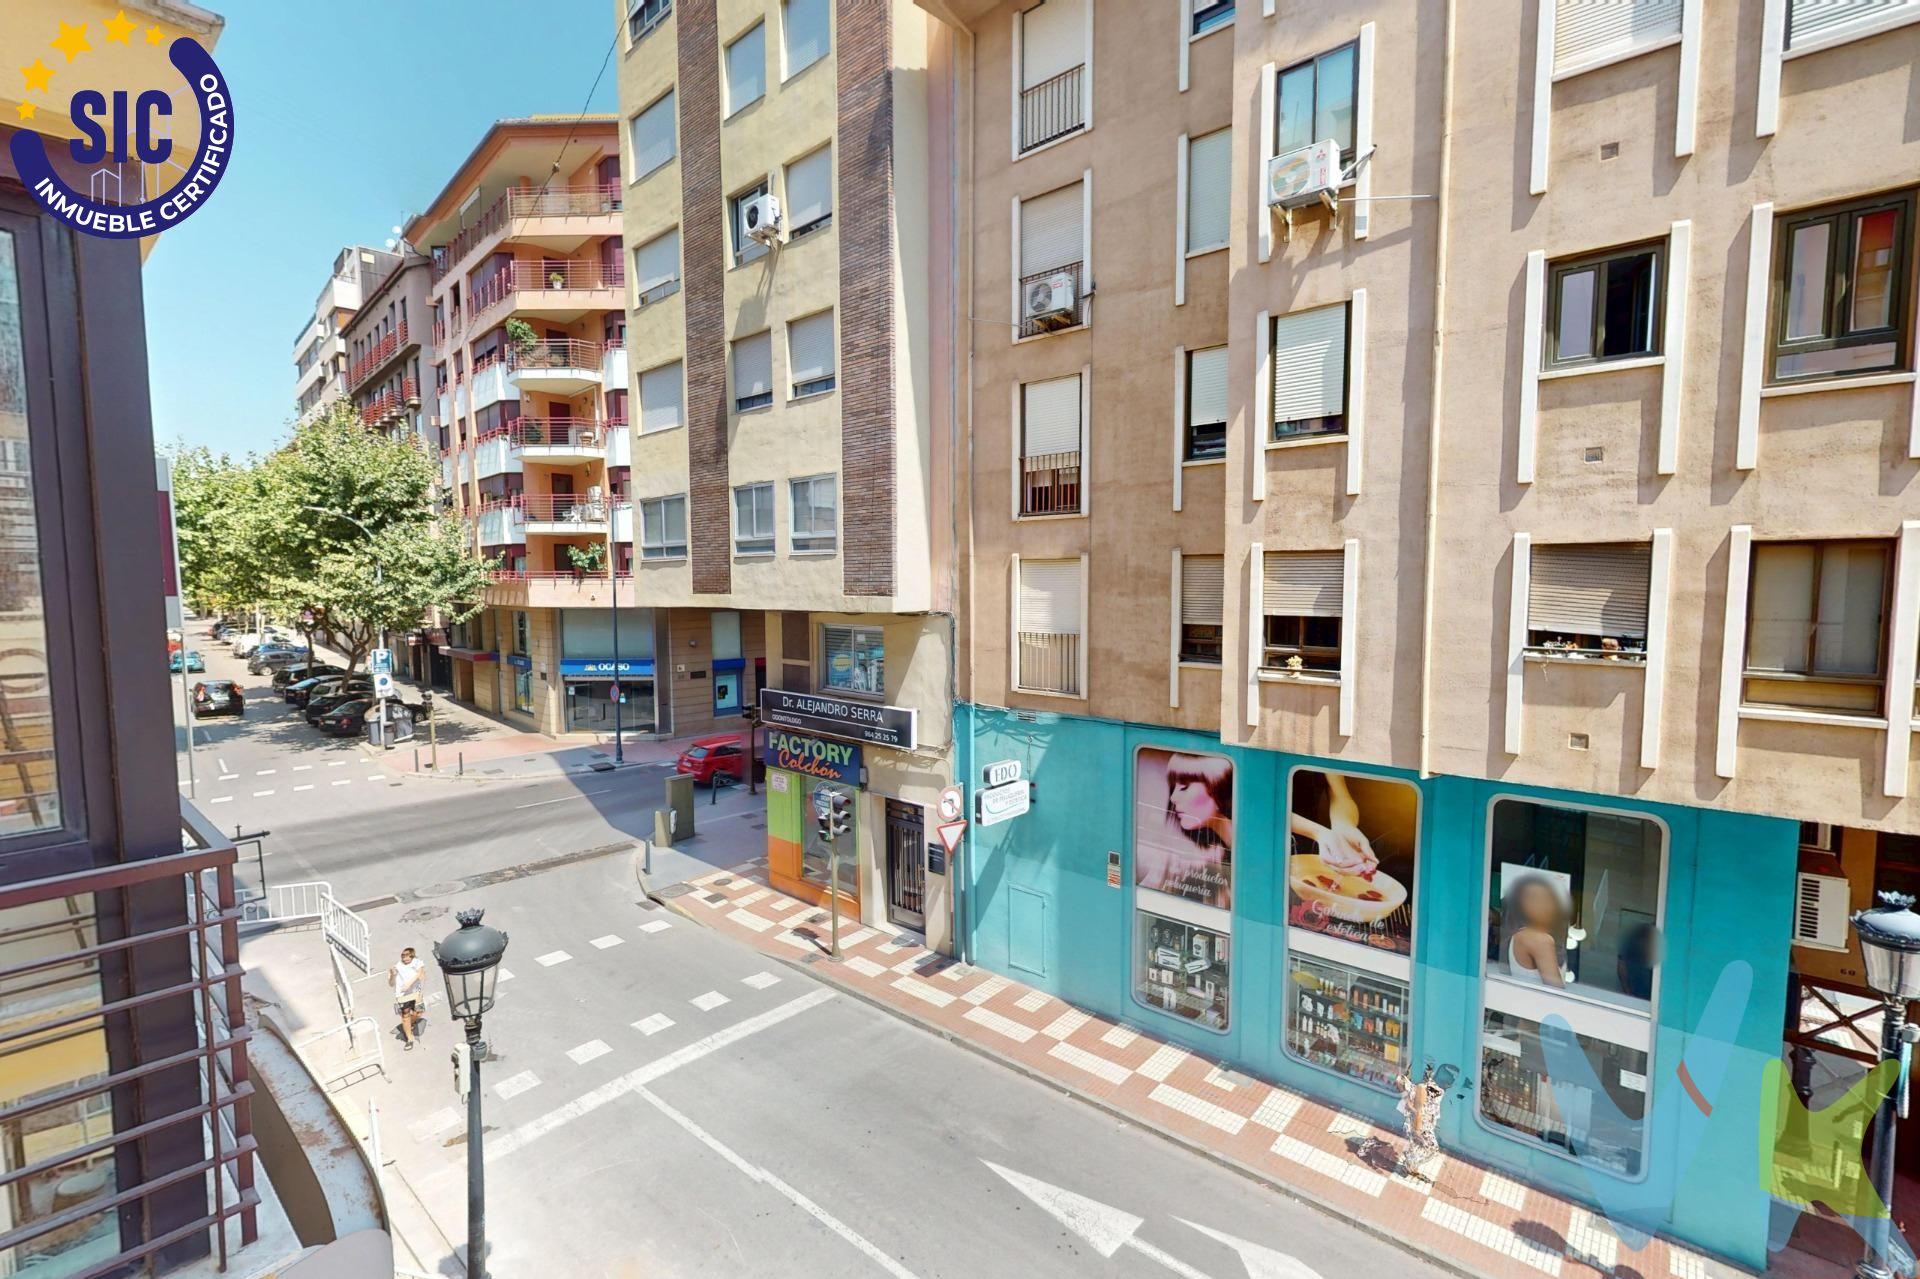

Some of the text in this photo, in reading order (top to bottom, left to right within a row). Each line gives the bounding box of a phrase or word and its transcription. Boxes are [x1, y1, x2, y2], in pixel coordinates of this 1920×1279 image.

[782, 696, 884, 723] Dr. ALEJANDRO SERRA
[768, 731, 853, 766] FACTORY
[778, 748, 842, 779] Colchón
